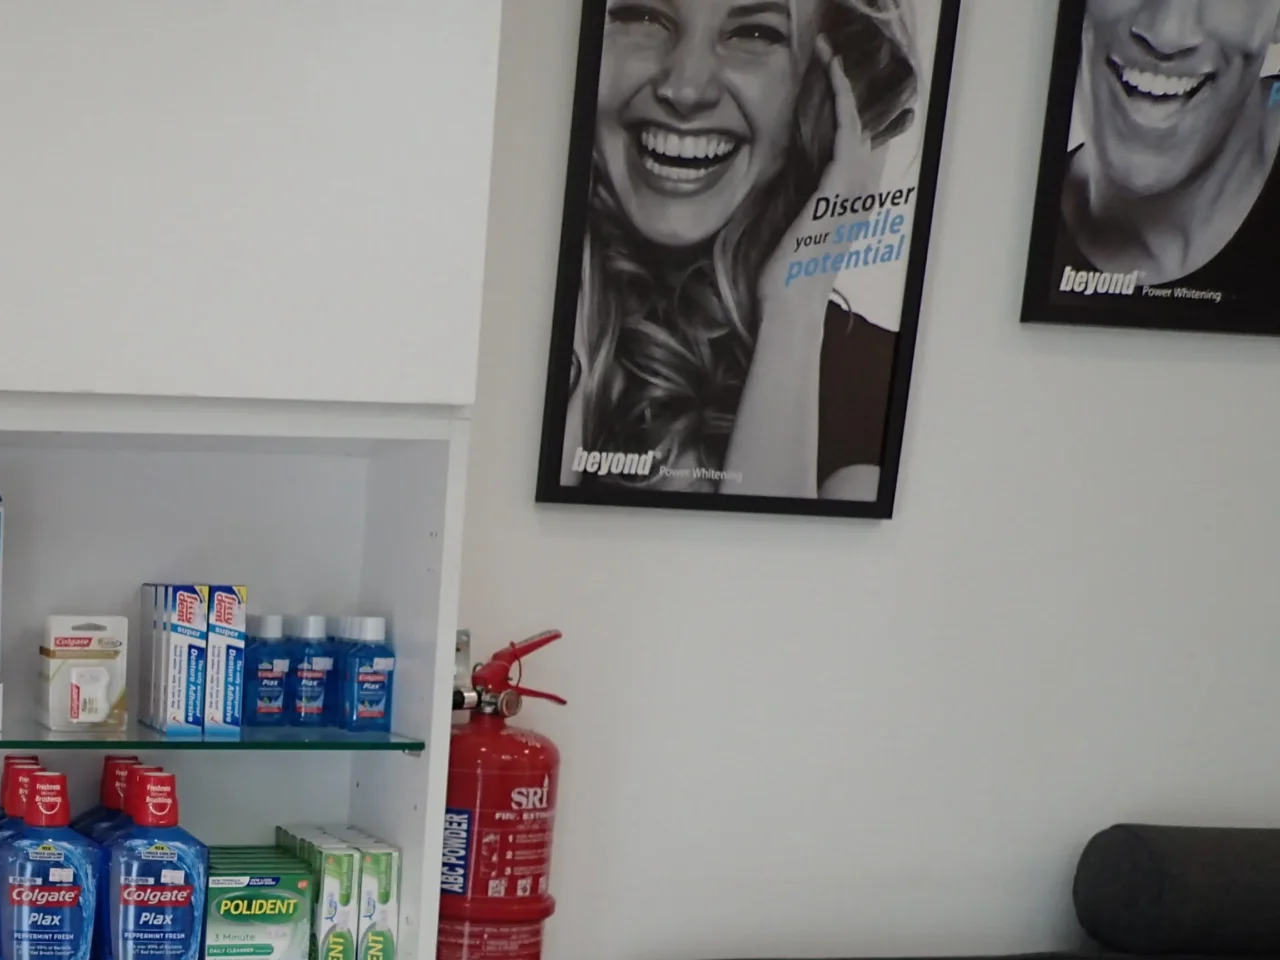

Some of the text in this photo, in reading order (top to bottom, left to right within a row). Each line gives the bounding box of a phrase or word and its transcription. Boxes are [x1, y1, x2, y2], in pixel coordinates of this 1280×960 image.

[812, 186, 916, 221] Discover
[793, 208, 905, 253] your smile
[785, 234, 906, 287] potential
[1059, 265, 1222, 303] beyond Power Whitening
[572, 447, 743, 482] beyond Power Whitening
[177, 627, 200, 637] super
[215, 627, 239, 637] super
[187, 648, 198, 722] Denture Adhesive
[226, 649, 236, 722] Denture Adhesive
[511, 781, 549, 810] SRI
[440, 813, 469, 893] ABC POWDER
[12, 888, 75, 905] Colgate
[123, 887, 187, 904] Colgate
[220, 899, 298, 915] POLIDENT
[28, 912, 62, 926] Plax
[139, 912, 173, 926] Plax
[14, 932, 53, 940] PEPPERMINT
[214, 933, 256, 942] 3 Minute
